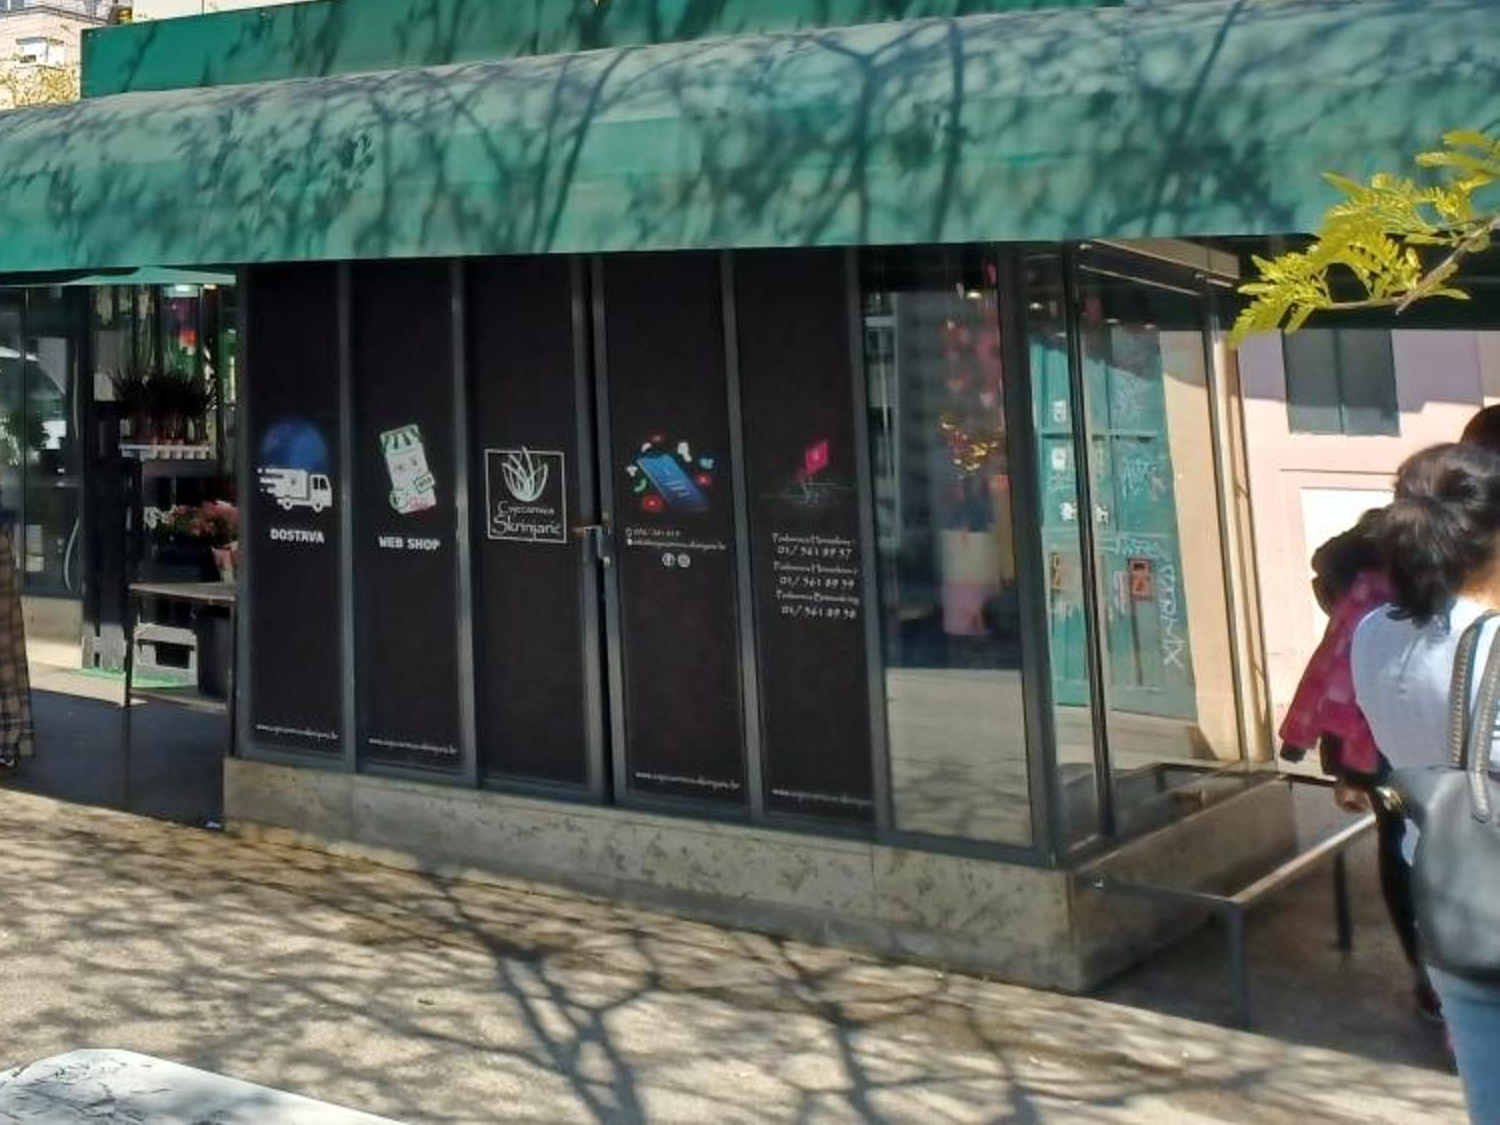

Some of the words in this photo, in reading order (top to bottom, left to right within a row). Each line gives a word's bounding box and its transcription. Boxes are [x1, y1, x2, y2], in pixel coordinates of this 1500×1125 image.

[269, 527, 325, 544] DOSTAVA
[378, 536, 403, 549] WEB
[406, 537, 441, 551] SHOP
